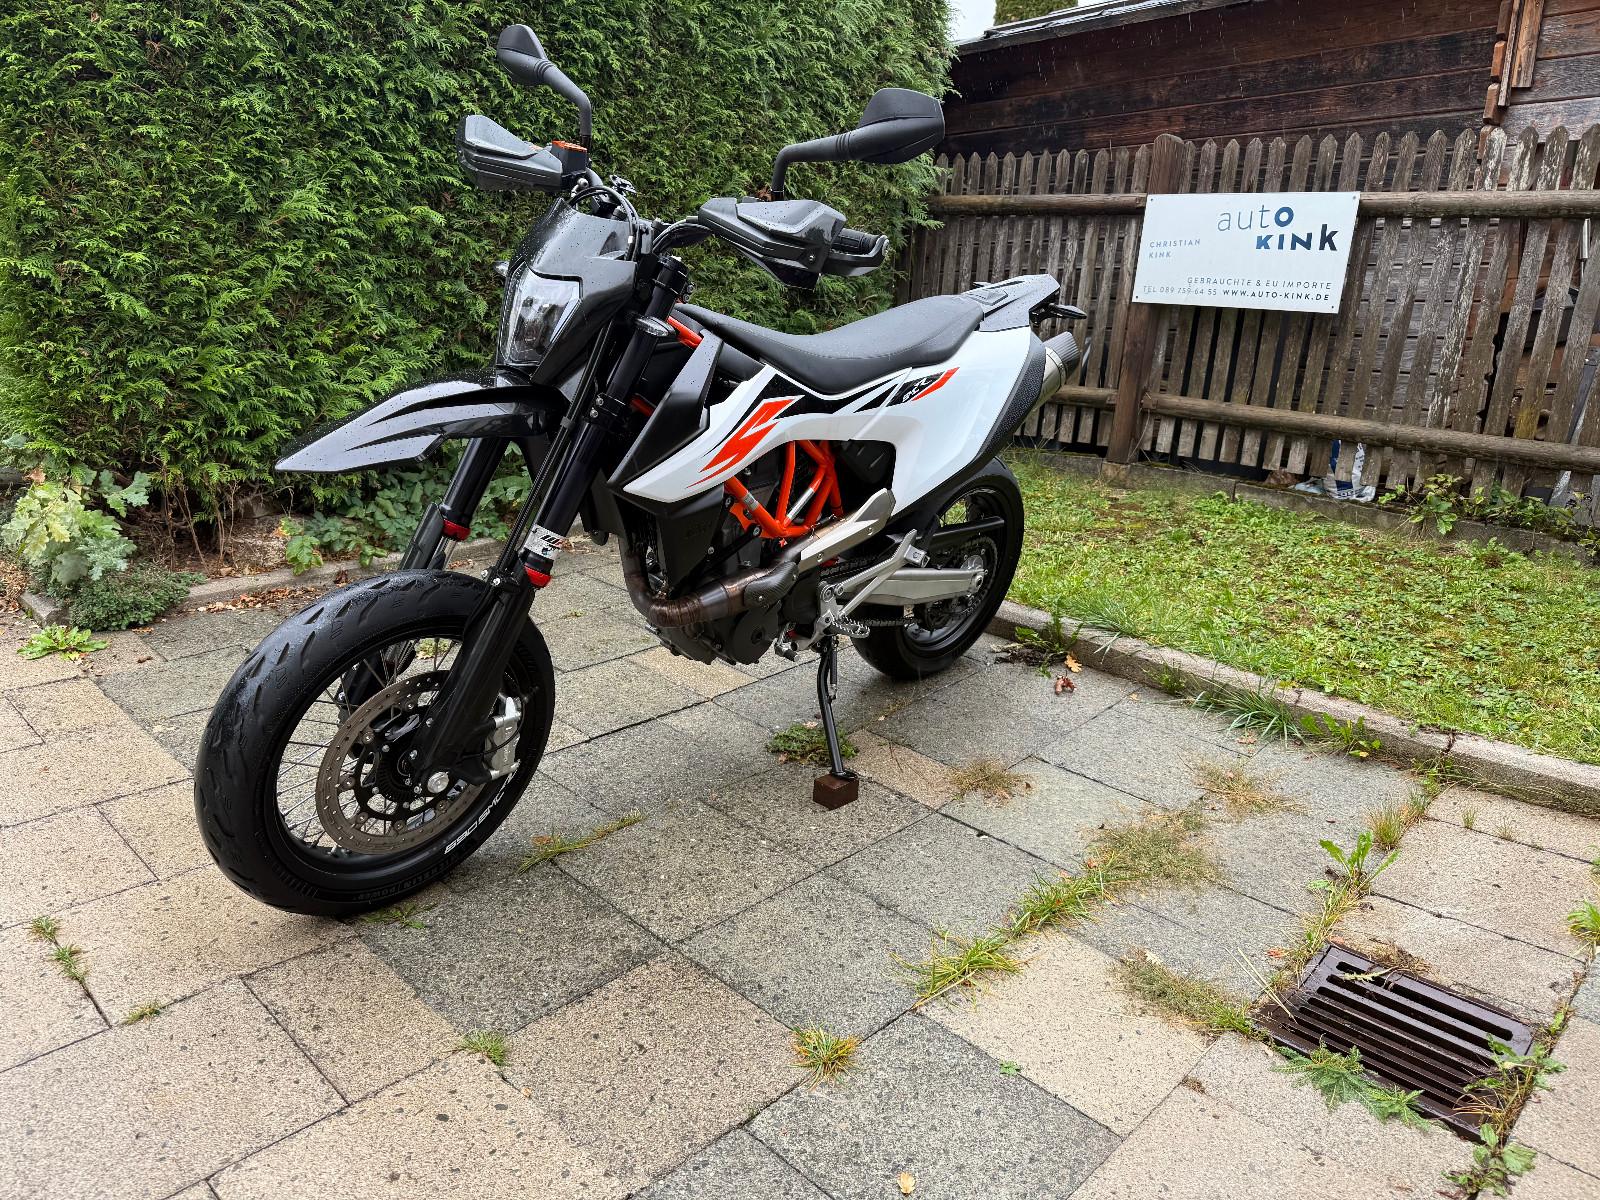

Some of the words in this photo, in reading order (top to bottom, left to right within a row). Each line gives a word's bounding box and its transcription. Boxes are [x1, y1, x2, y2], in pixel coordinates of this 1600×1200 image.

[1217, 204, 1294, 231] auto
[1149, 238, 1201, 248] CHRISTIAN
[1149, 251, 1172, 259] KINK
[1187, 277, 1251, 287] GEBRAUCHTE
[1255, 279, 1262, 287] &
[1265, 279, 1278, 288] EU
[1282, 280, 1332, 290] IMPORTE
[1143, 286, 1157, 294] TEL
[1159, 286, 1175, 294] 089
[1222, 289, 1330, 301] WWW.AUTO-KINK.DE
